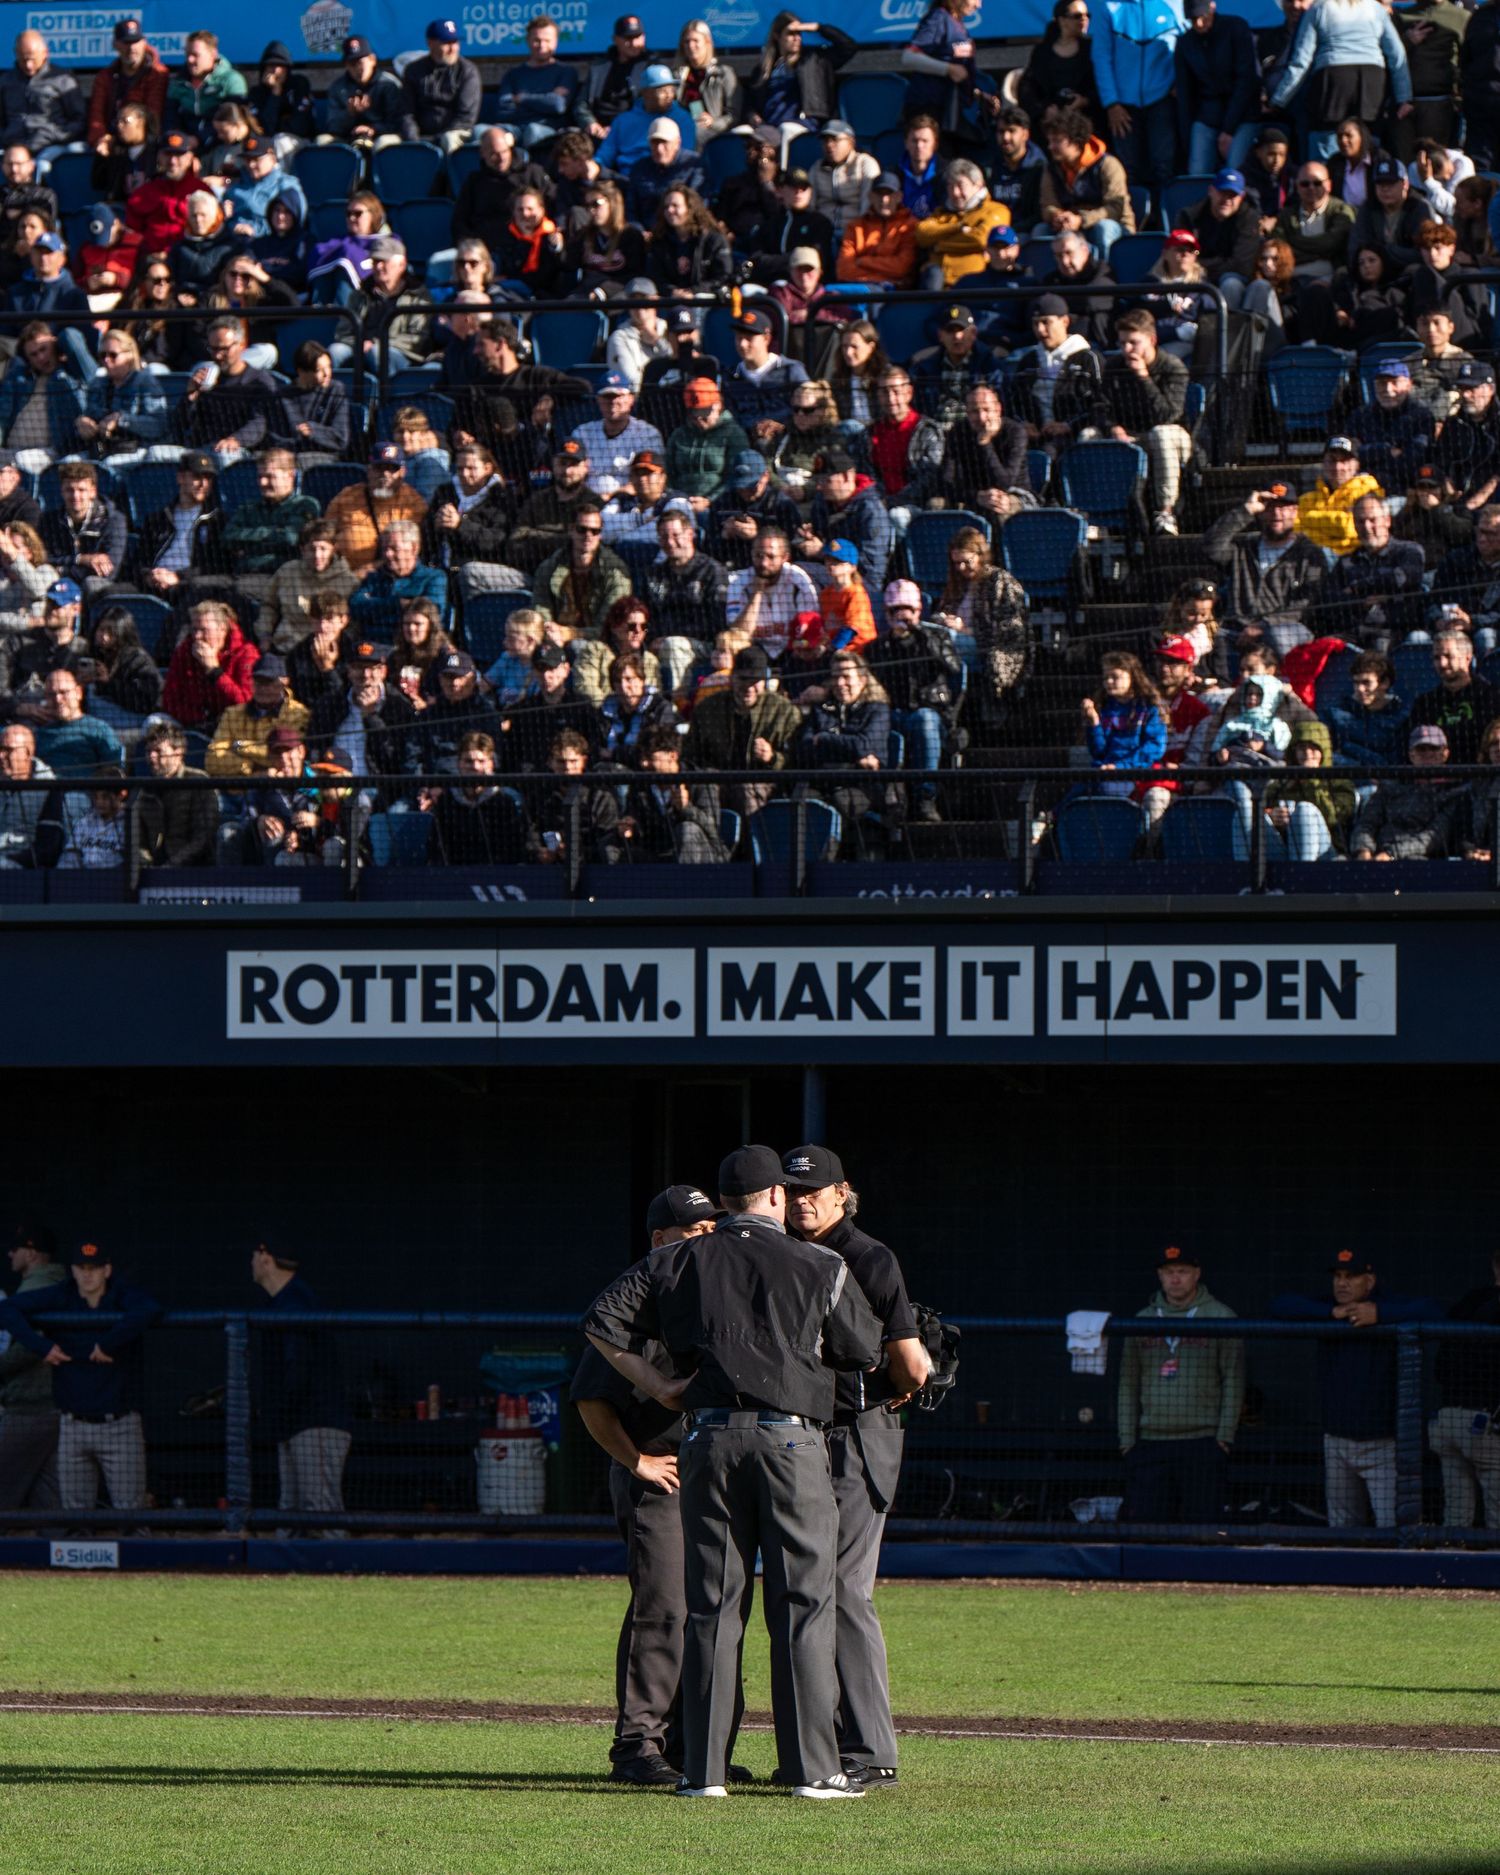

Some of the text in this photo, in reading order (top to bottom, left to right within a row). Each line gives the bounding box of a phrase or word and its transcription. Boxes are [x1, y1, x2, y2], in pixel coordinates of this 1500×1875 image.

[463, 0, 587, 21] rotterdam
[464, 20, 587, 46] TOPSRT
[48, 38, 78, 53] AKE
[87, 38, 102, 52] IT
[239, 958, 1358, 1025] ROTTERDAM. MAKE IT HAPPEN
